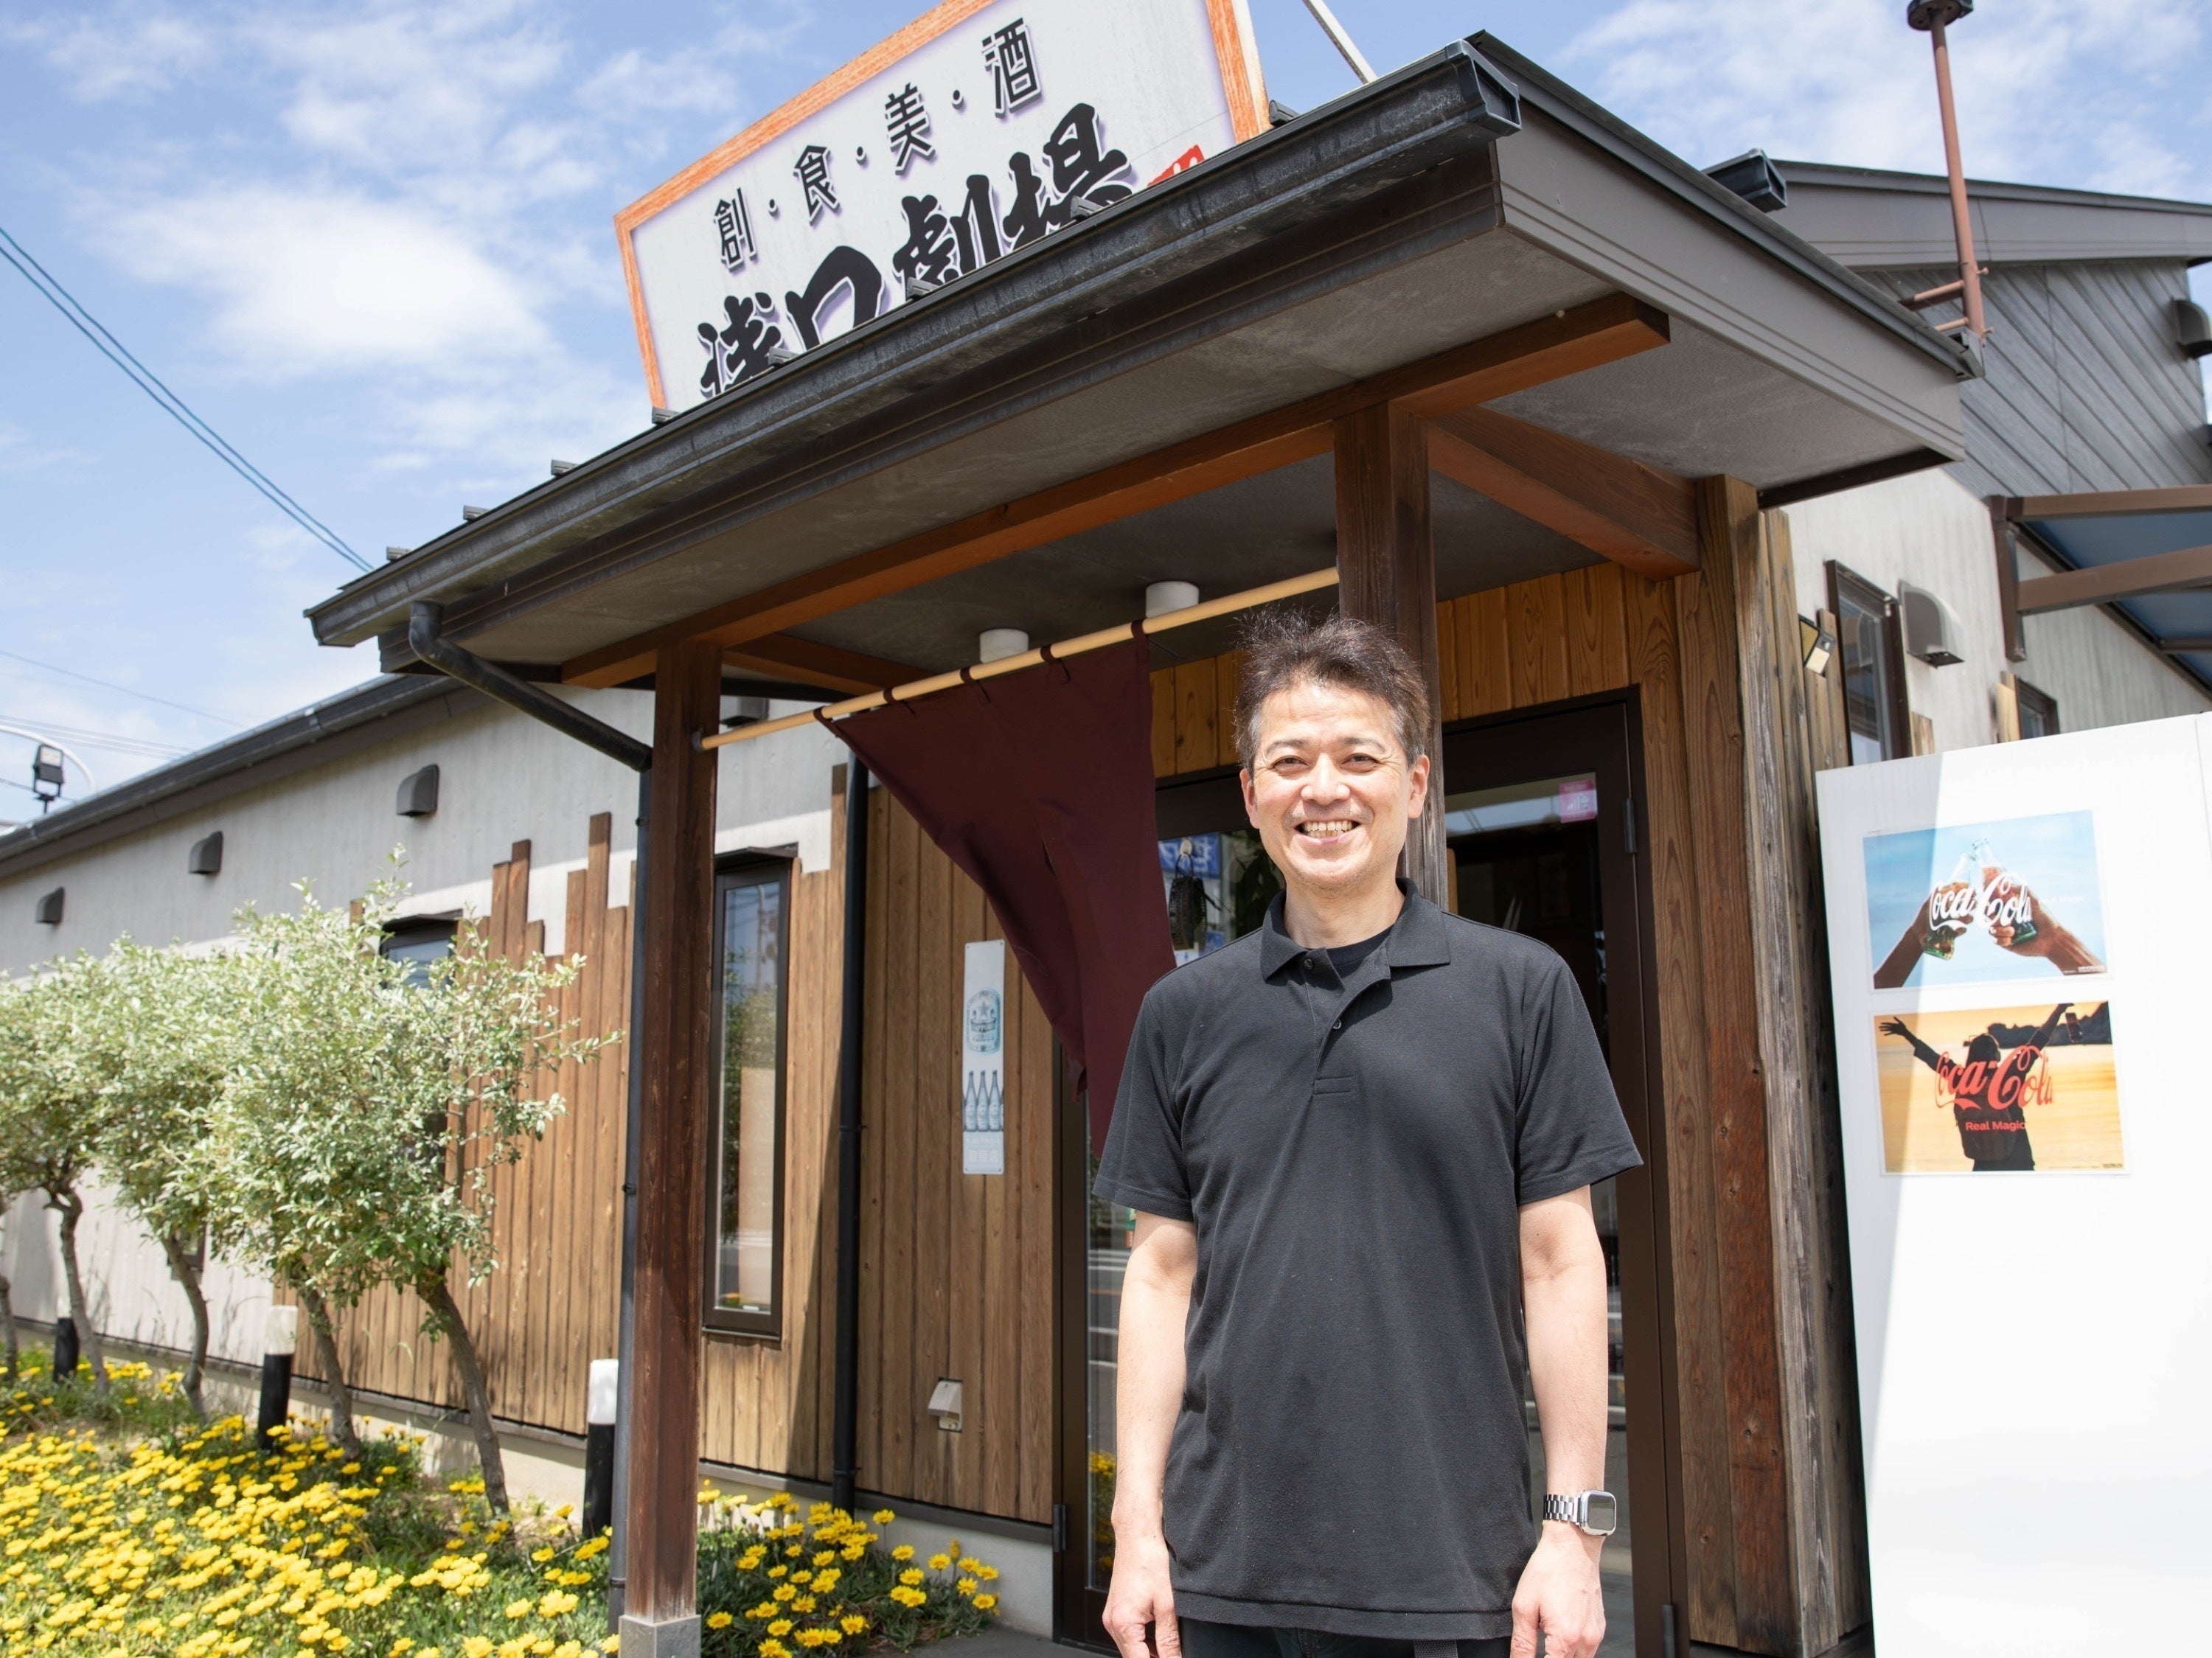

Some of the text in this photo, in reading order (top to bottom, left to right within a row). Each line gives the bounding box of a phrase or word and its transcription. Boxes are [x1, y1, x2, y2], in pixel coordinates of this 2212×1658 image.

[1930, 872, 2033, 931] Coca-Cola
[1935, 1045, 2053, 1111] Coca-Cola
[1965, 1120, 2026, 1132] Real Magic
